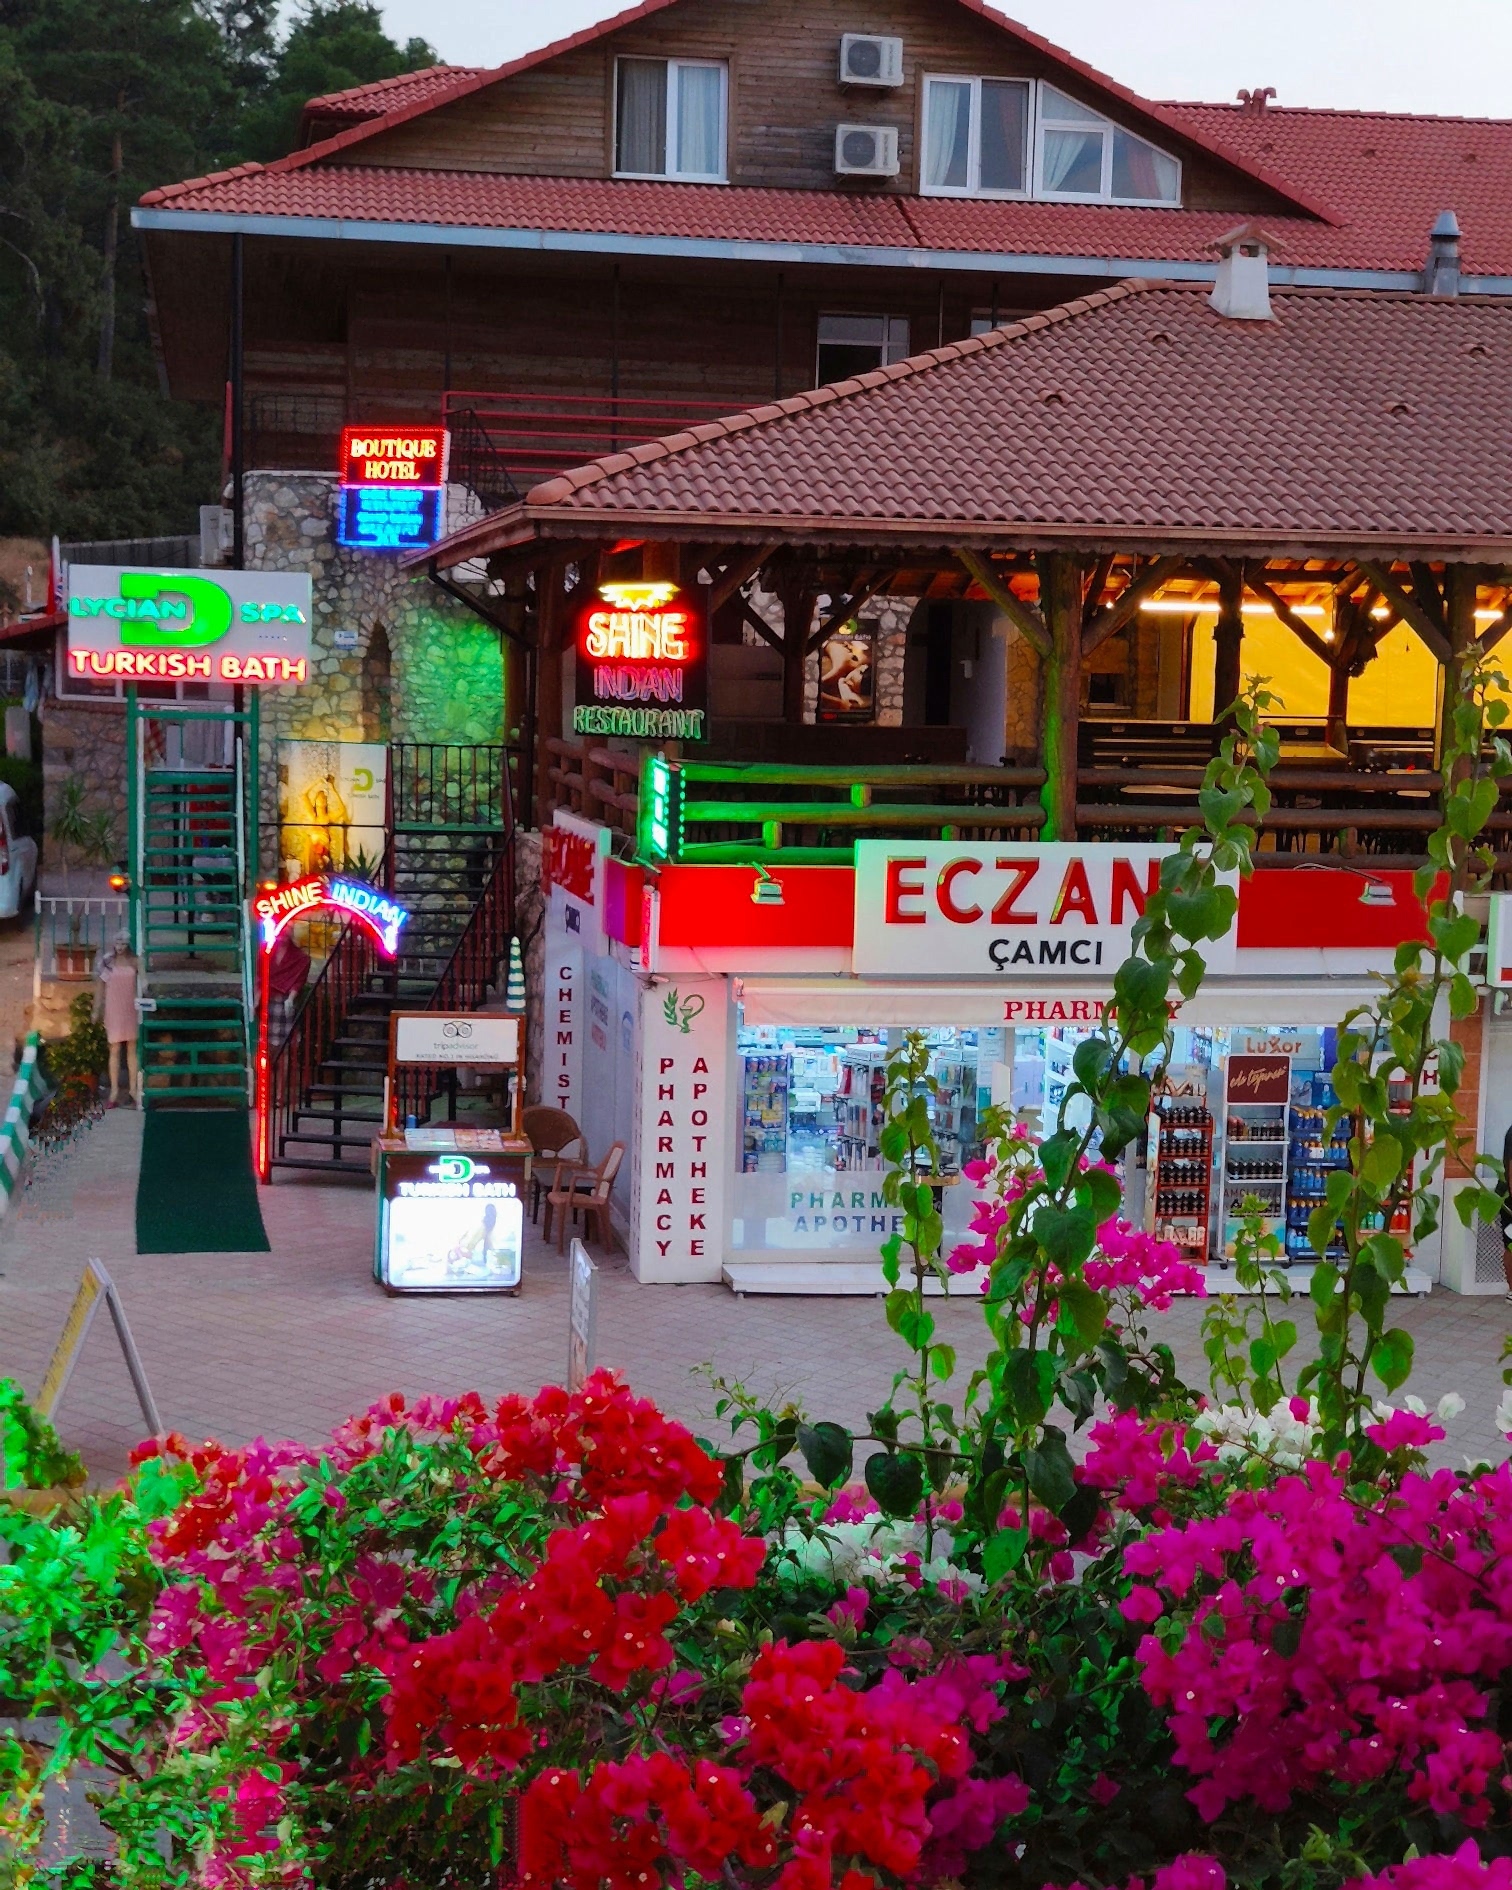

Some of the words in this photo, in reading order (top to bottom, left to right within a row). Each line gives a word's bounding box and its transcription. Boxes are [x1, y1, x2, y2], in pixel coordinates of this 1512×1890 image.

[351, 438, 437, 459] BOUTIQUE
[365, 461, 420, 479] HOTEL
[69, 597, 186, 619] LYCIAN
[240, 602, 306, 624] SPA
[586, 612, 690, 660] SHINE
[71, 650, 211, 677] TURKISH
[221, 655, 306, 682] BATH
[594, 665, 683, 703] INDIAN
[573, 704, 705, 739] RESTAURANT
[256, 881, 323, 918] SHINE
[331, 882, 407, 929] INDIAN
[885, 856, 1182, 925] ECZAN
[988, 939, 1102, 971] ÇAMCI
[1004, 1001, 1182, 1021] PHARMY
[557, 967, 573, 1110] CHEMIST
[656, 1057, 674, 1257] PHARMACY
[690, 1057, 709, 1256] APOTHEKE
[791, 1191, 888, 1209] PHARM
[794, 1215, 904, 1232] APOTHE
